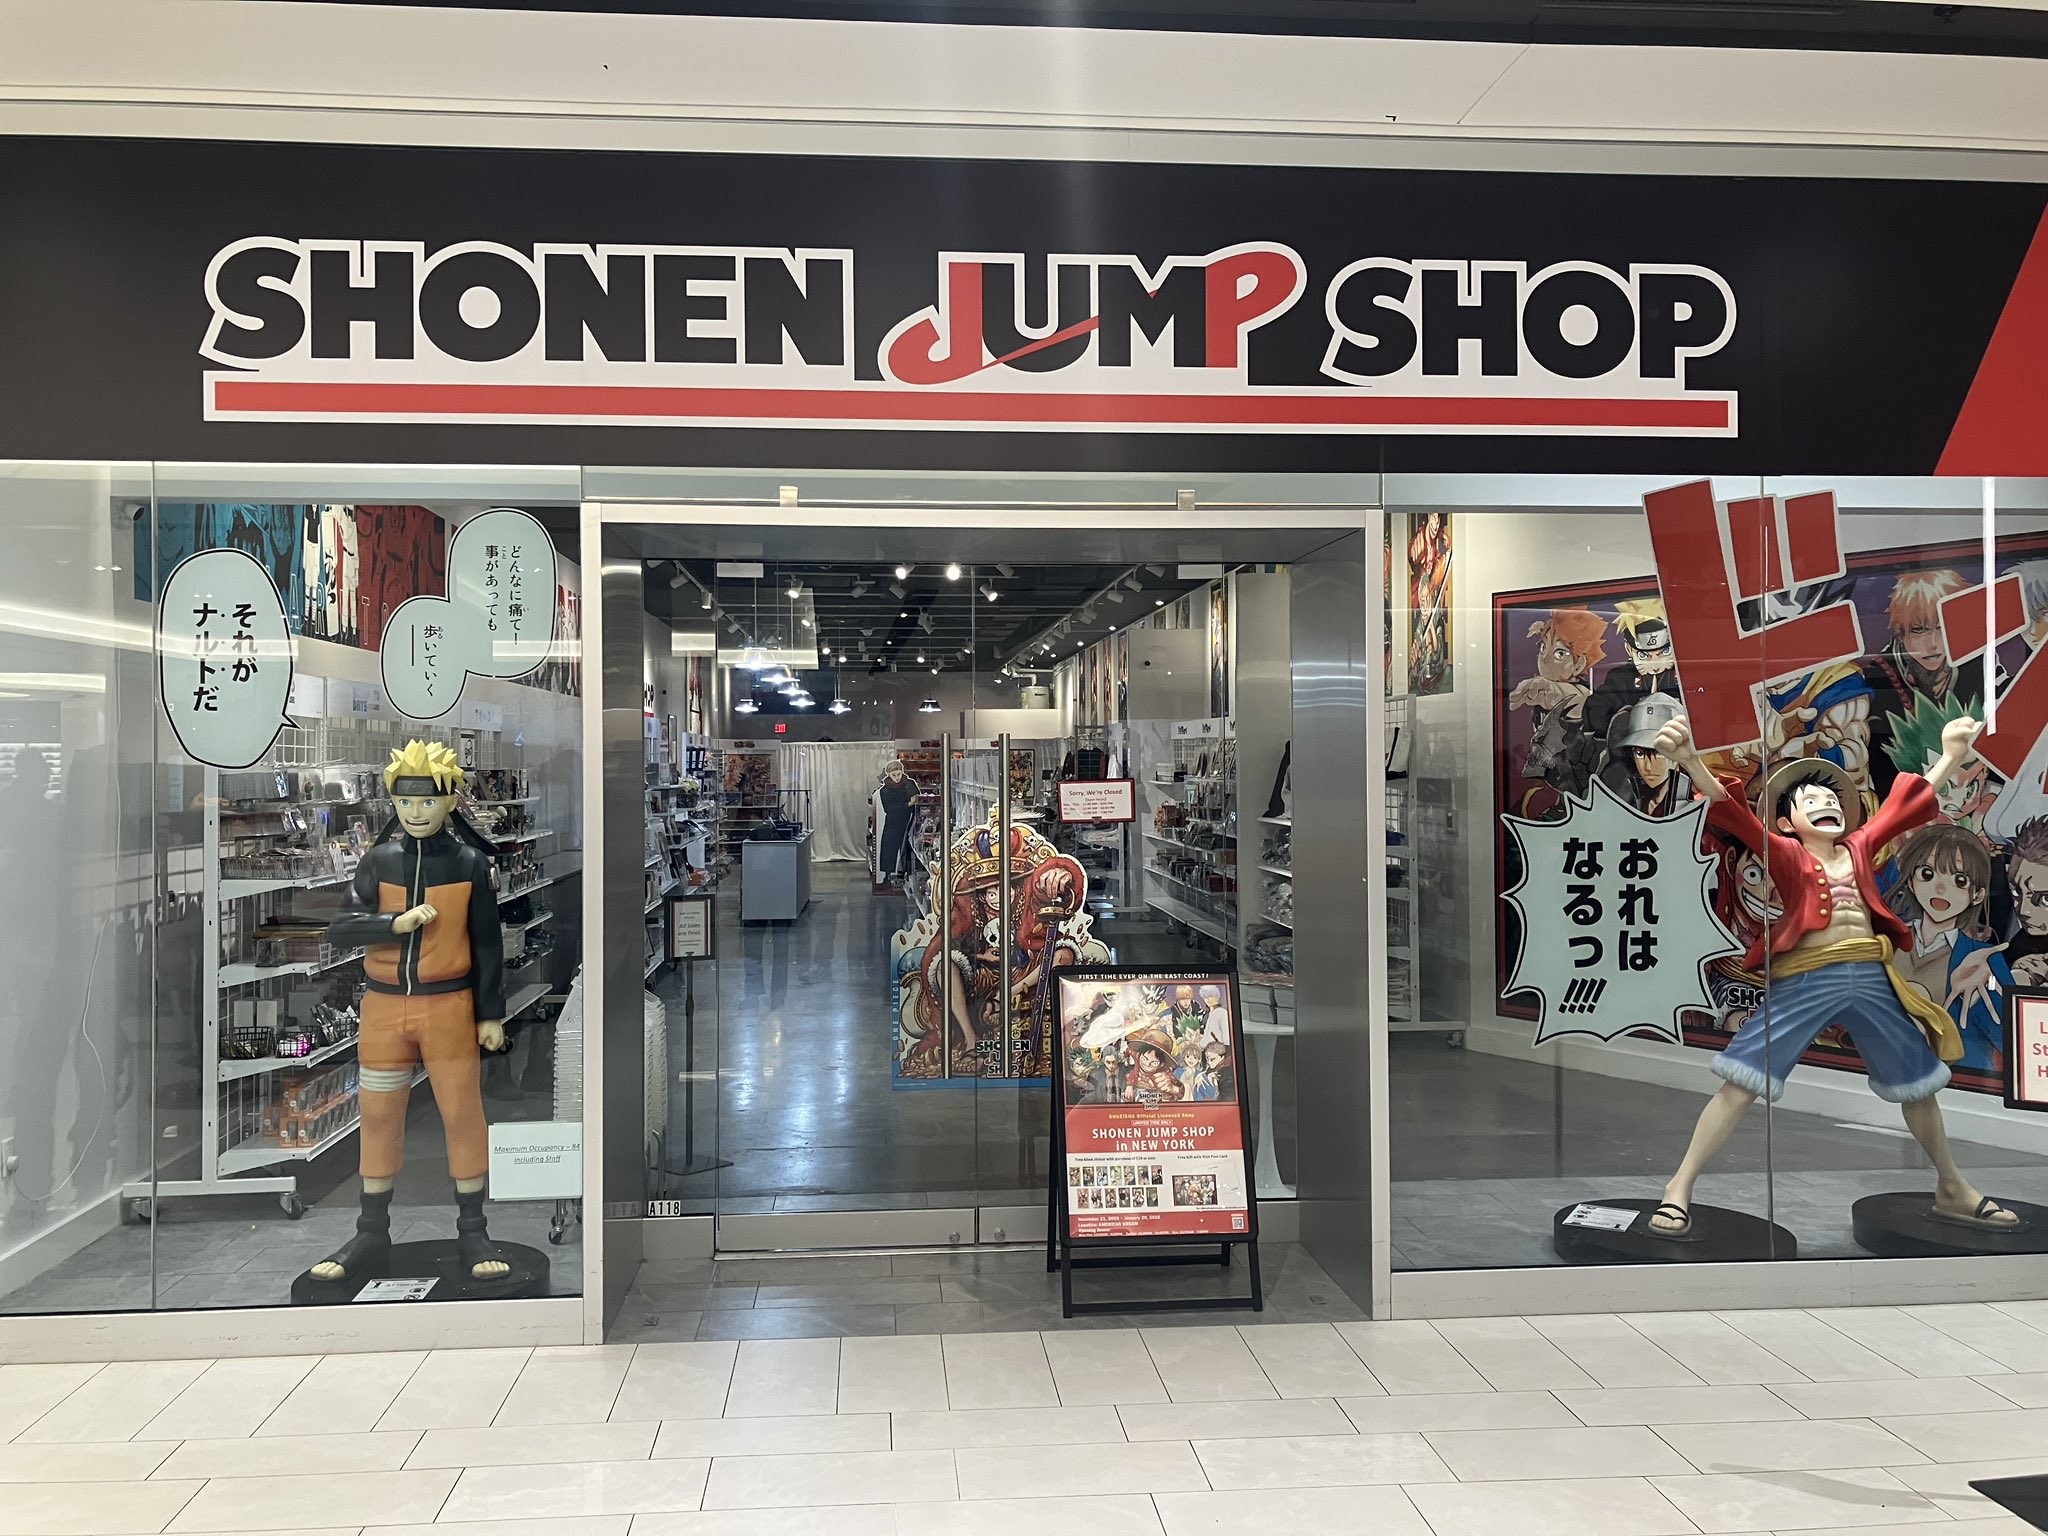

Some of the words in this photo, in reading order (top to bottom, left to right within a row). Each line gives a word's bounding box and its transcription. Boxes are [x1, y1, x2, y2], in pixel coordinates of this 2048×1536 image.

[206, 240, 852, 372] SHONEN
[883, 245, 1302, 388] JUMP
[1335, 262, 1734, 381] SHOP
[485, 545, 499, 631] 事があっても
[193, 602, 219, 712] ナルトだ
[232, 603, 259, 682] それが
[424, 624, 438, 697] 歩いていく
[1617, 837, 1660, 971] おれは
[977, 1040, 1031, 1051] SHOEN
[494, 1145, 527, 1153] Maximum
[529, 1144, 564, 1152] Occupancy
[572, 1143, 580, 1151] 84
[1092, 1128, 1142, 1139] SHONEN
[1145, 1127, 1178, 1138] JUMP
[1182, 1126, 1215, 1137] SHOP
[1116, 1141, 1128, 1151] in
[1132, 1140, 1158, 1150] NEW
[1162, 1139, 1195, 1150] YORK
[514, 1156, 544, 1164] Including
[545, 1155, 561, 1164] Staff
[649, 1201, 680, 1216] A118
